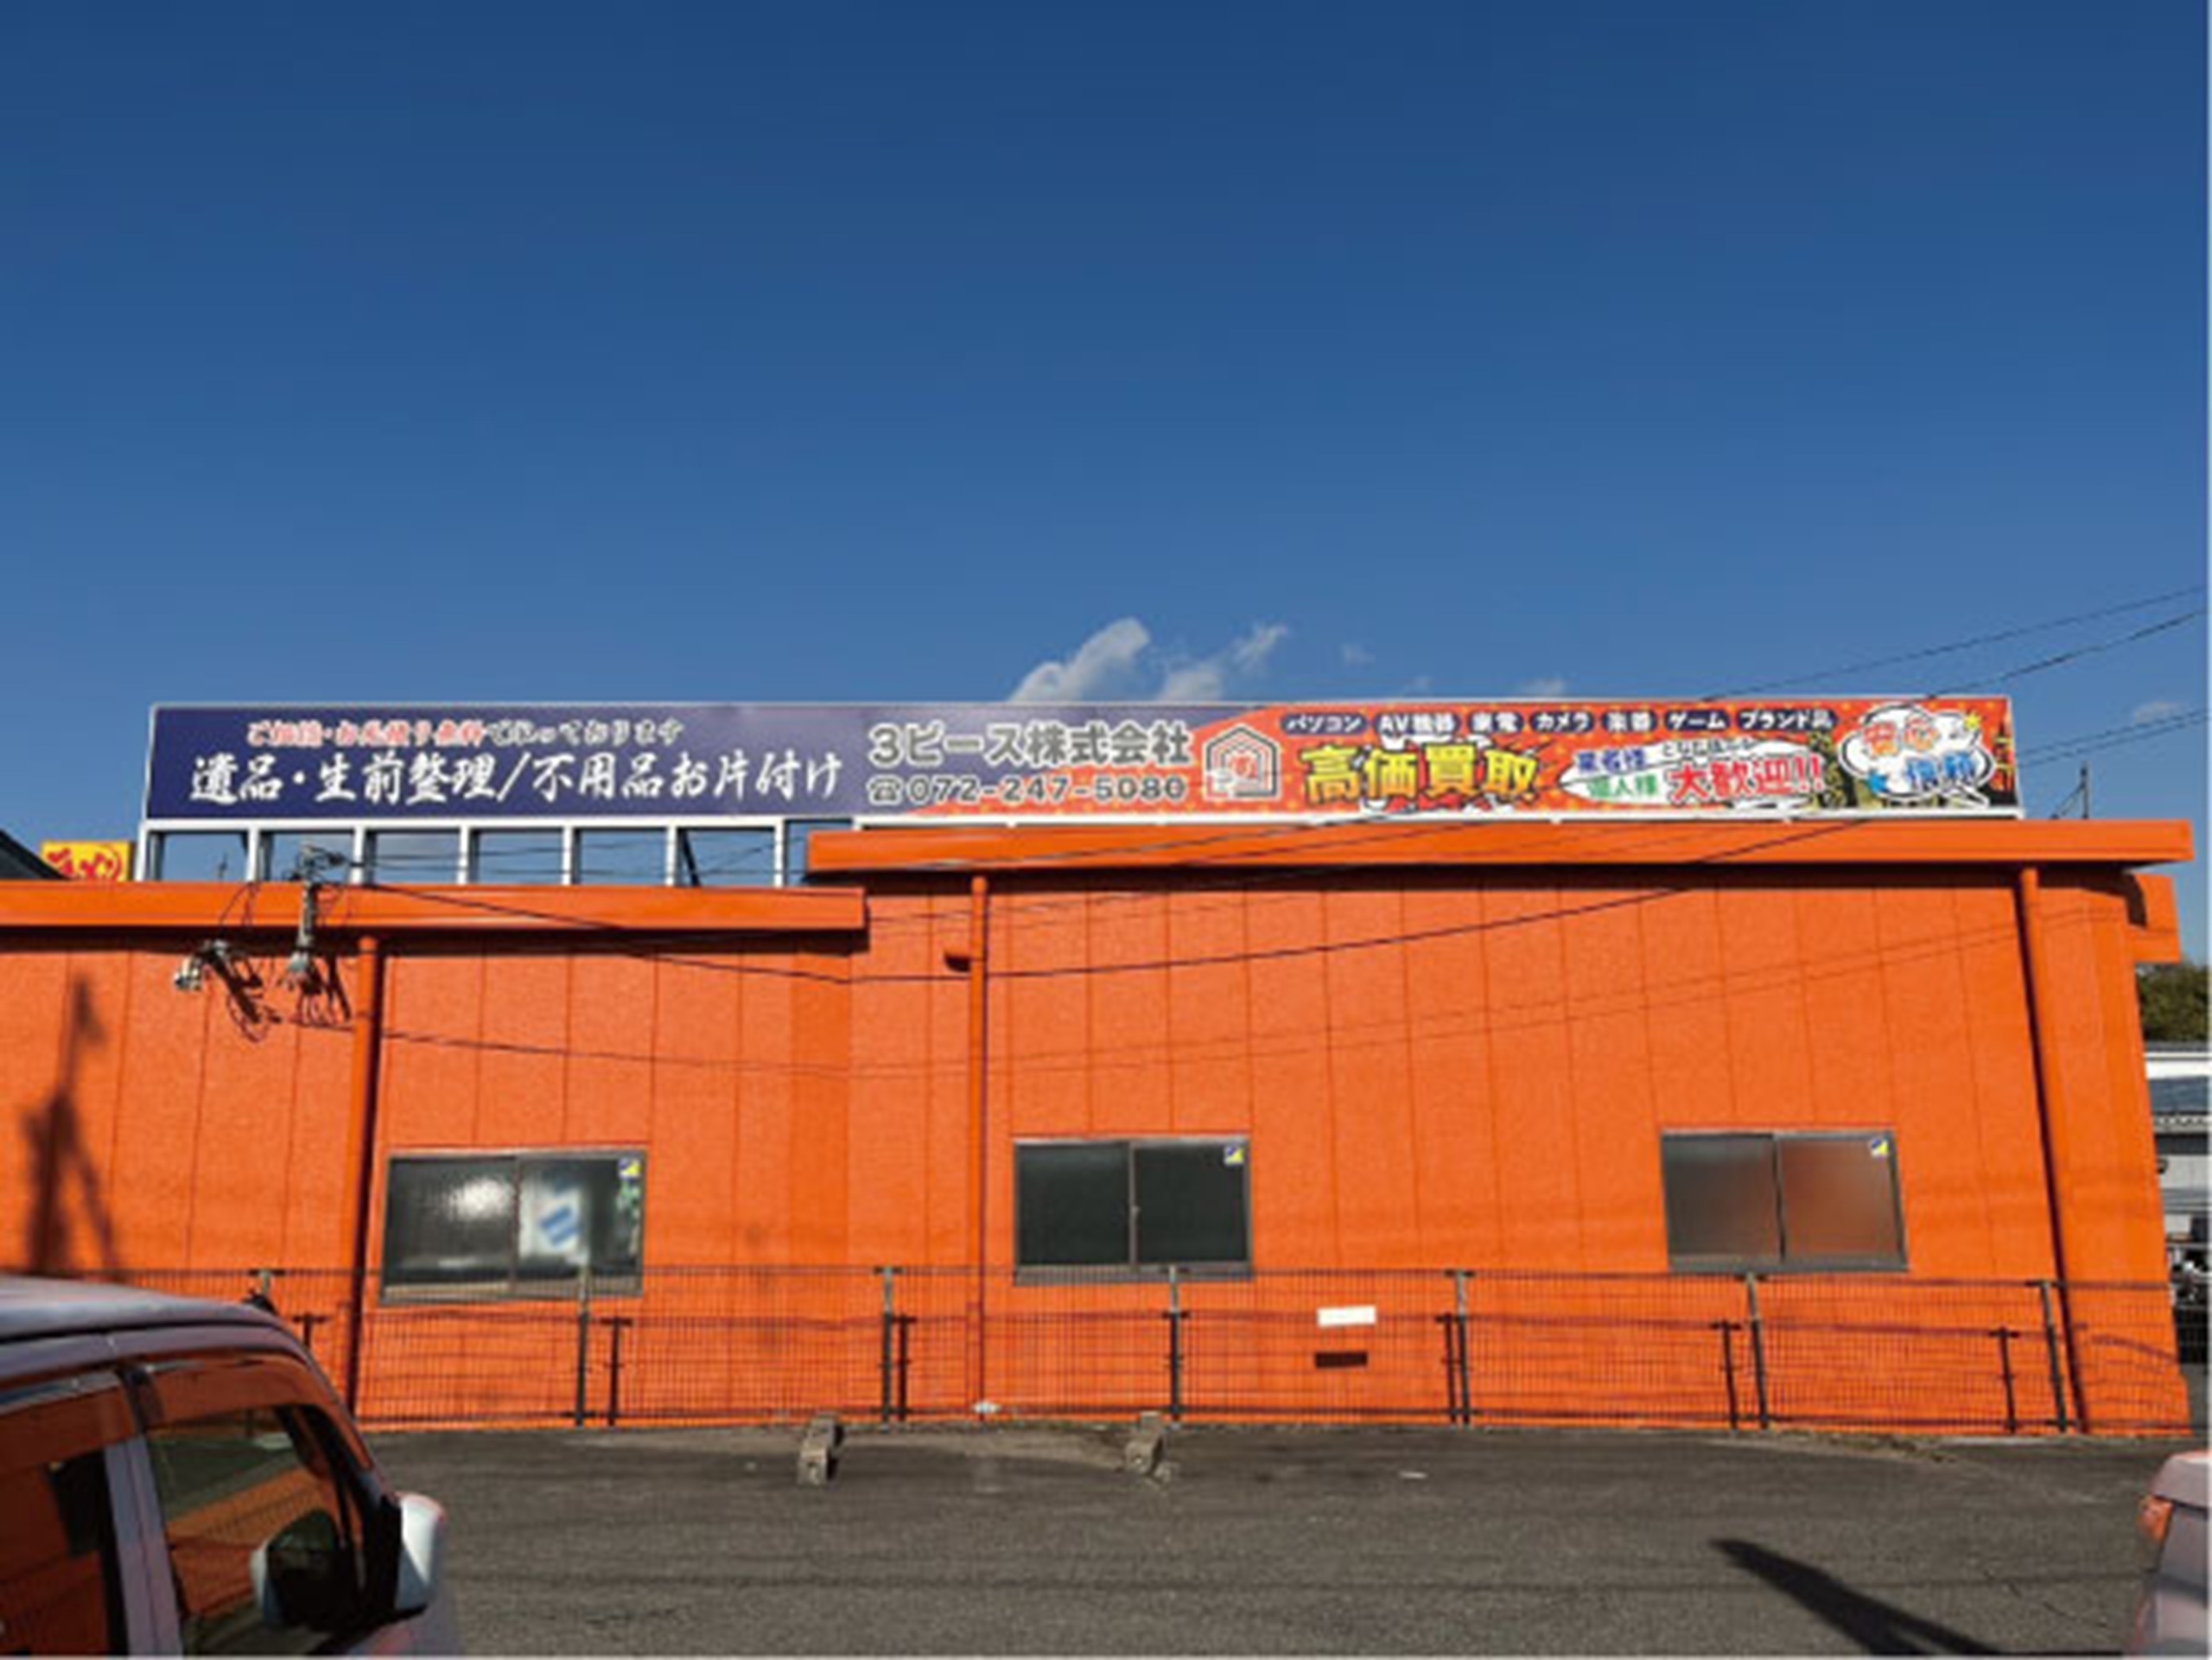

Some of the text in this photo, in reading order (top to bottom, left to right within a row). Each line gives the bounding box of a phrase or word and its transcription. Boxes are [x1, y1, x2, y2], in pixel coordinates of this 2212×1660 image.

[1285, 715, 1363, 733] パソコン
[1535, 711, 1591, 732] カメラ
[1668, 711, 1727, 730] ゲーム
[869, 719, 1193, 766] 3ピース株式会社
[907, 773, 1188, 803] 072-247-5080
[1300, 743, 1539, 805] 高価買取
